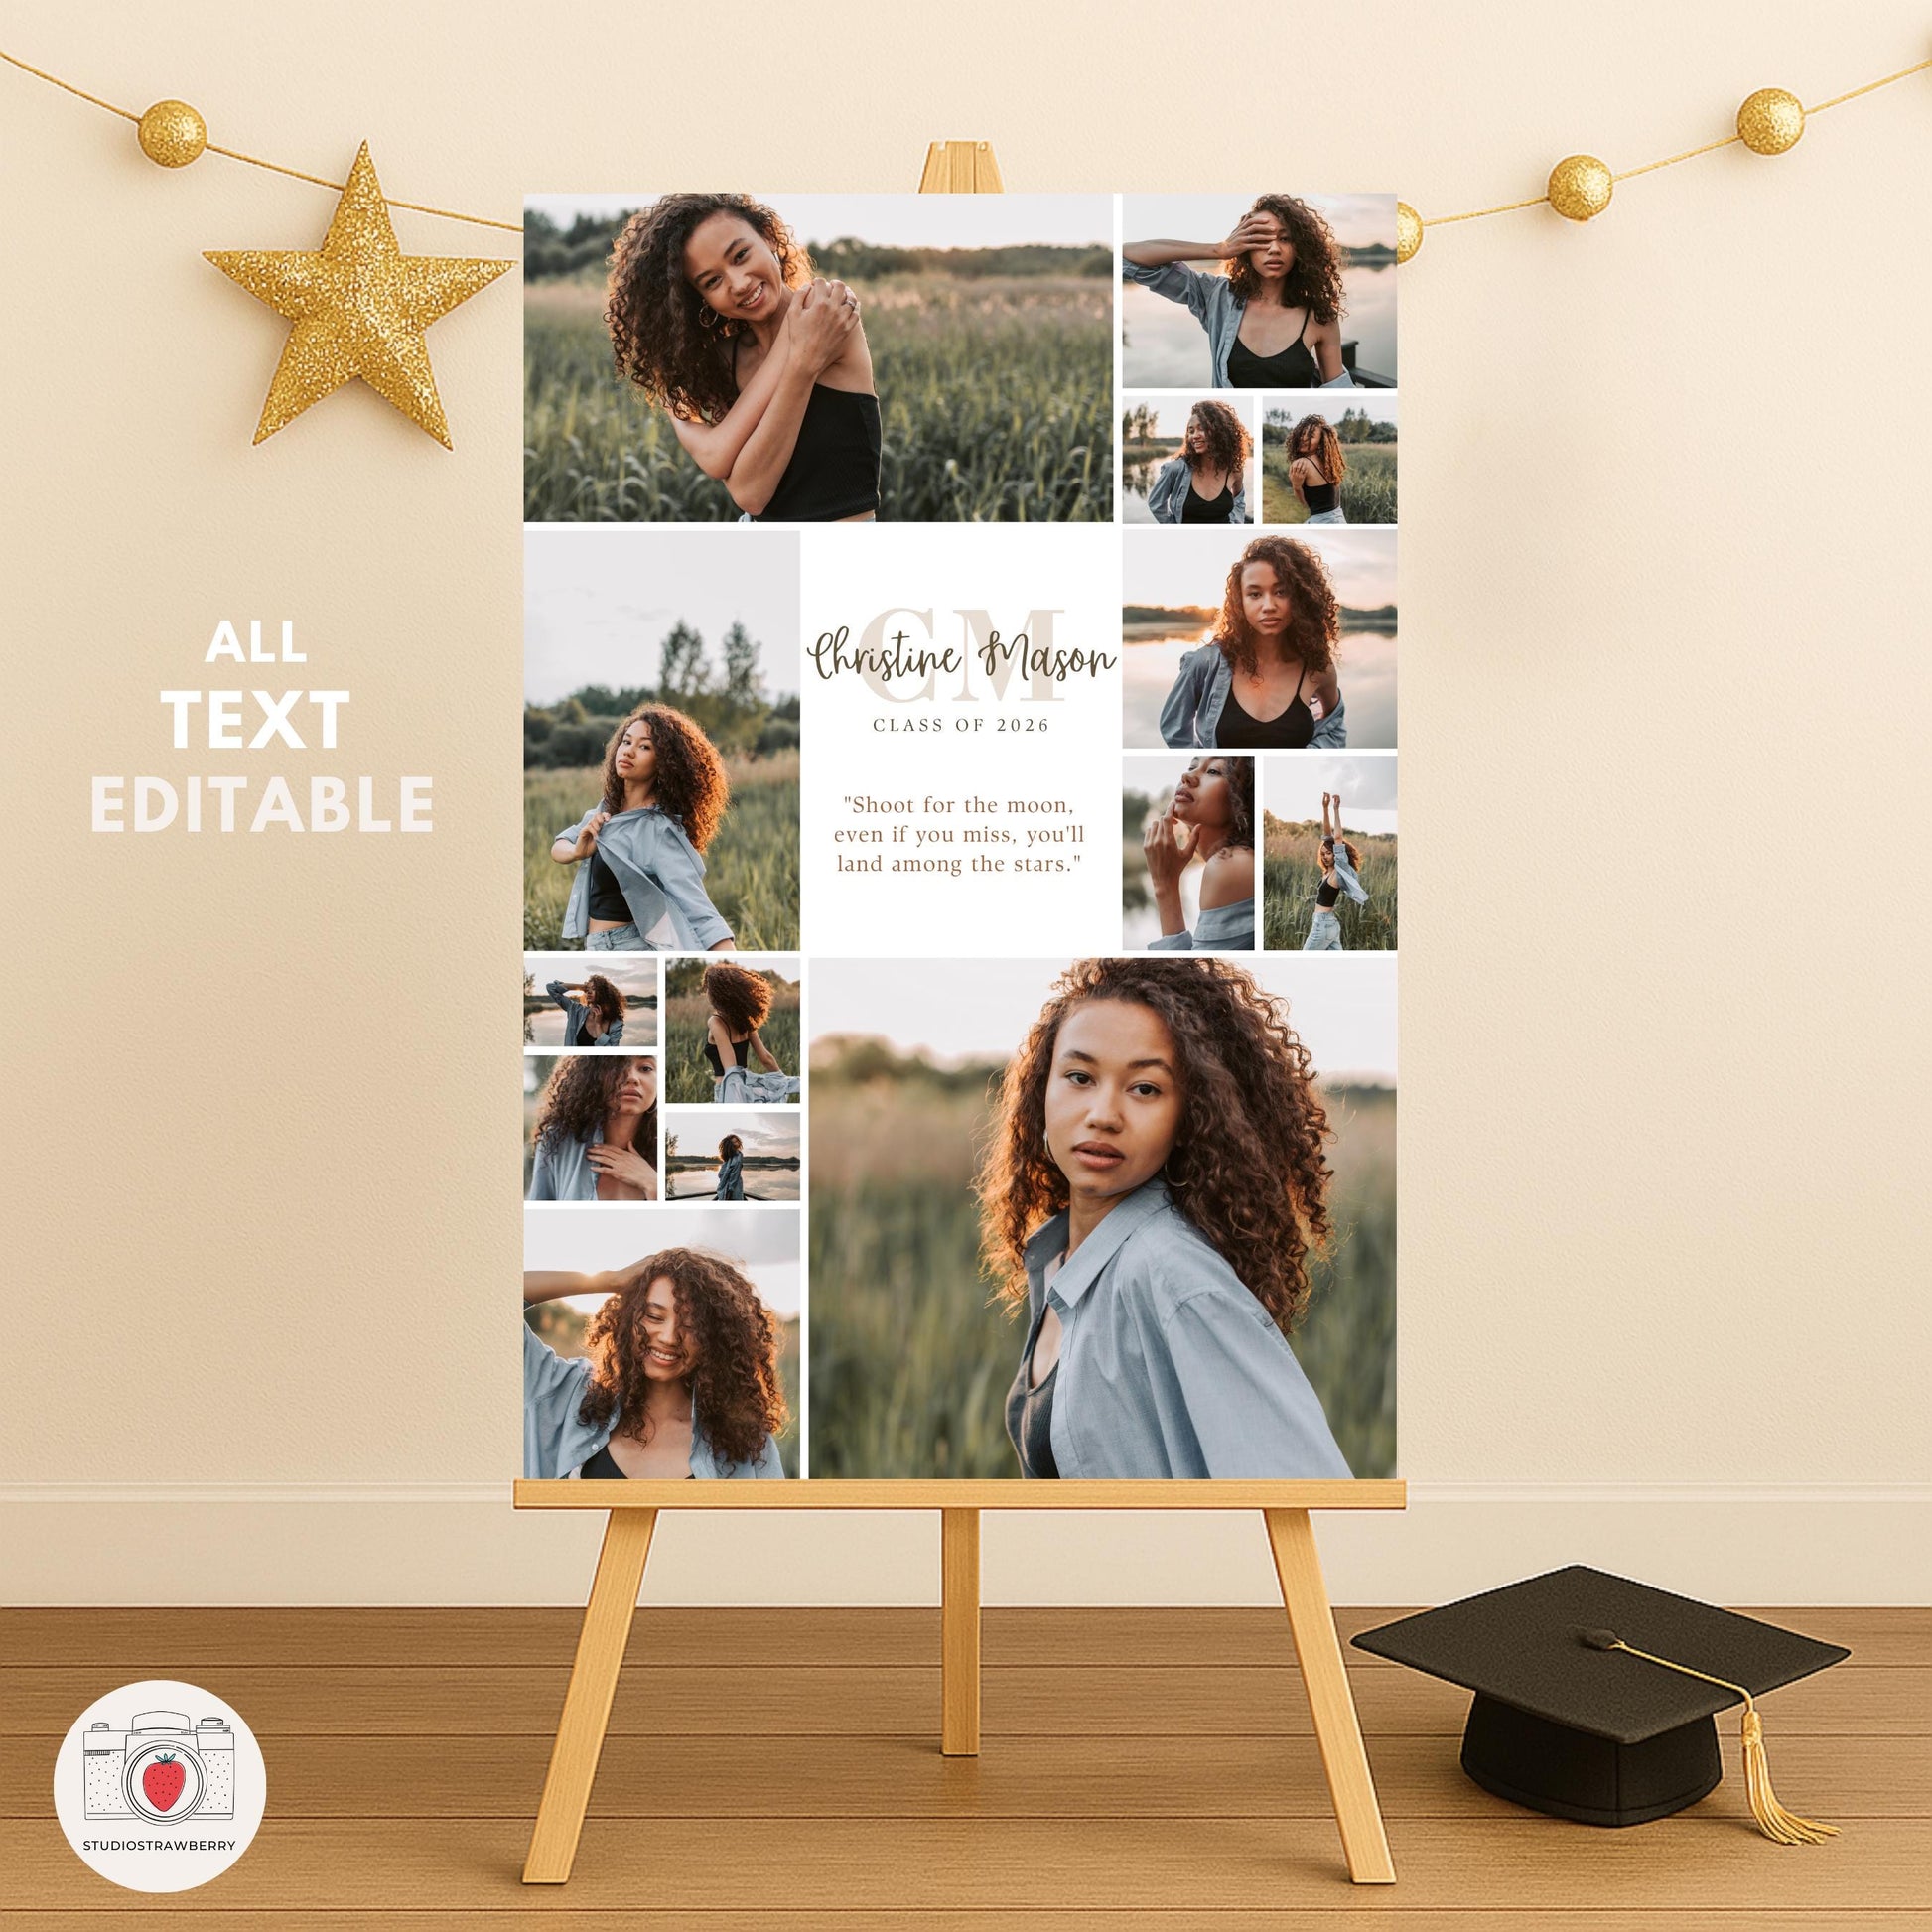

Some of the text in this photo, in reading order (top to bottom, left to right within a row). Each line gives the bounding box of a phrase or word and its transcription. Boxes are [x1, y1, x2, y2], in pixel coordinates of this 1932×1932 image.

[806, 625, 1118, 682] Christine Mason
[857, 607, 1065, 704] CM
[873, 718, 1048, 732] CLASS OF 2026
[844, 796, 1073, 816] "Shoot for the moon,
[834, 825, 1084, 848] even if you miss, you'll
[837, 854, 1081, 878] land among the stars."
